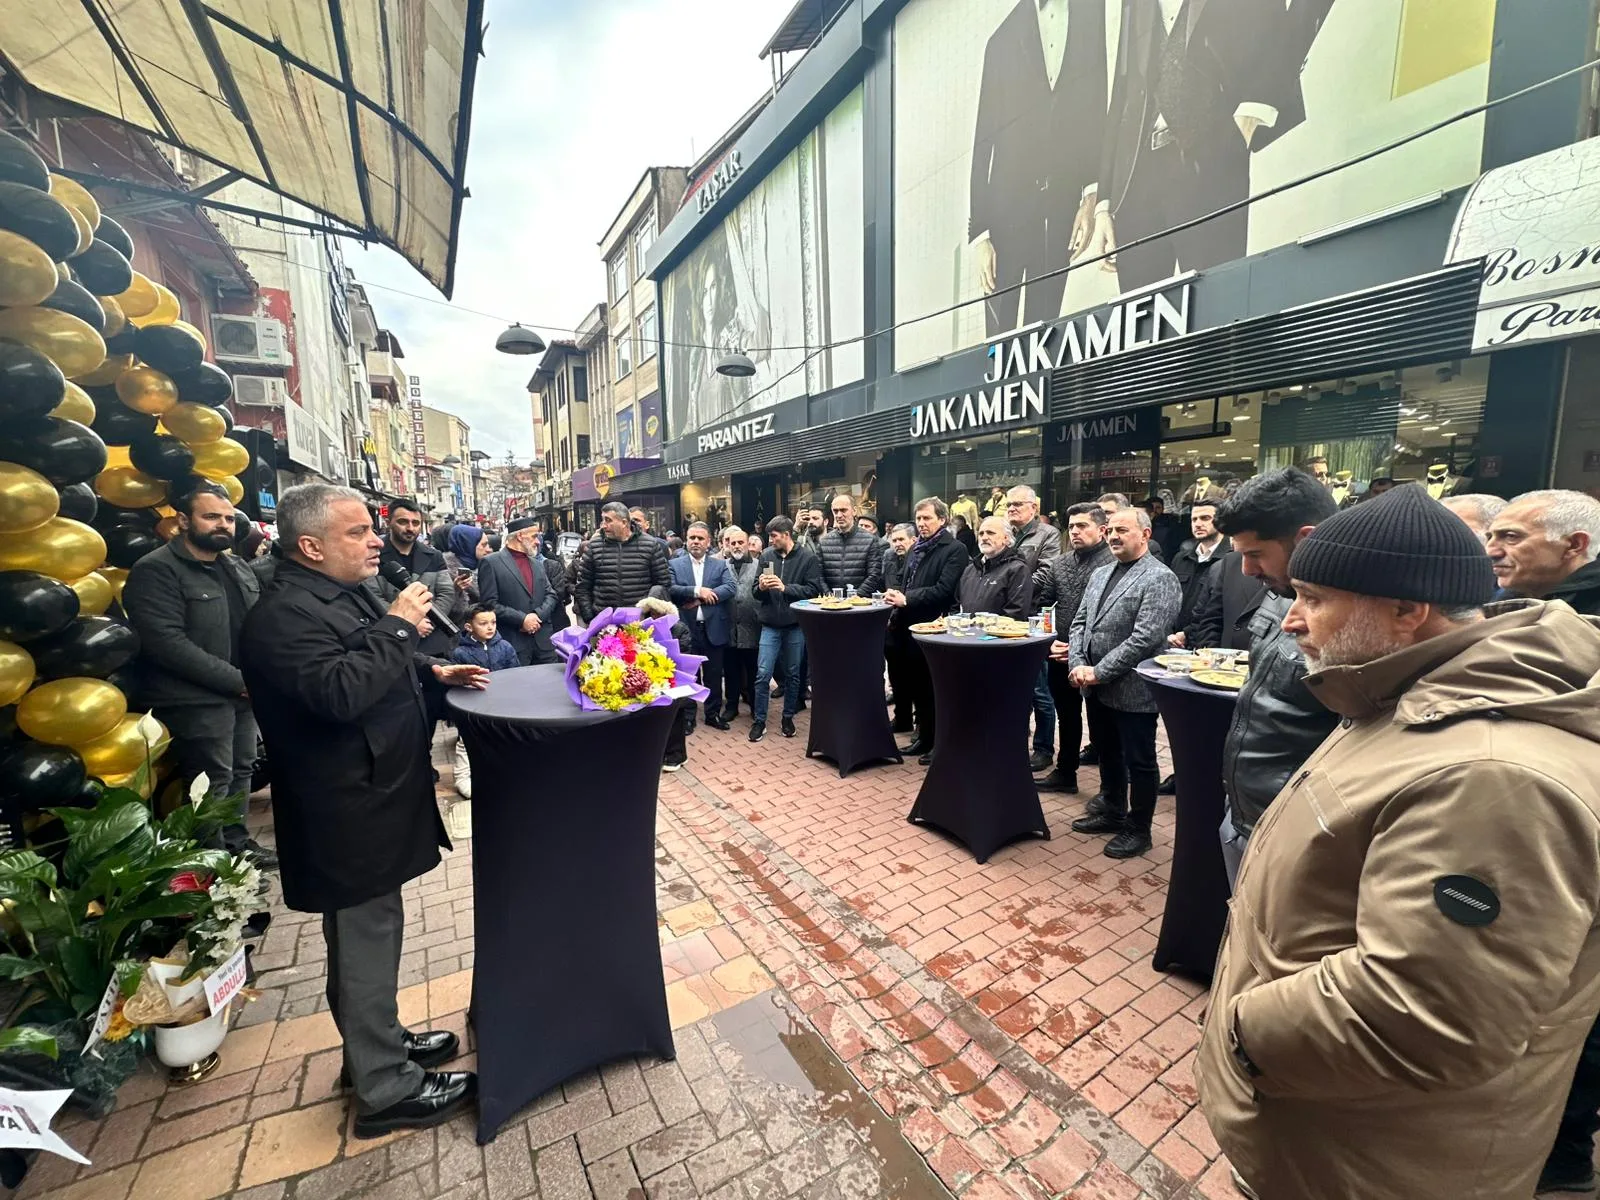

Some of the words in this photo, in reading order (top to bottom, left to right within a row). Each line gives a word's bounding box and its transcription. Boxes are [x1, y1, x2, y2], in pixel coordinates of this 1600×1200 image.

[983, 284, 1190, 384] JAKAMEN
[1487, 302, 1600, 345] Par
[410, 376, 423, 432] HOTEL
[909, 376, 1045, 438] JAKAMEN
[1057, 413, 1137, 442] JAKAMEN
[697, 413, 775, 453] PARANTEZ
